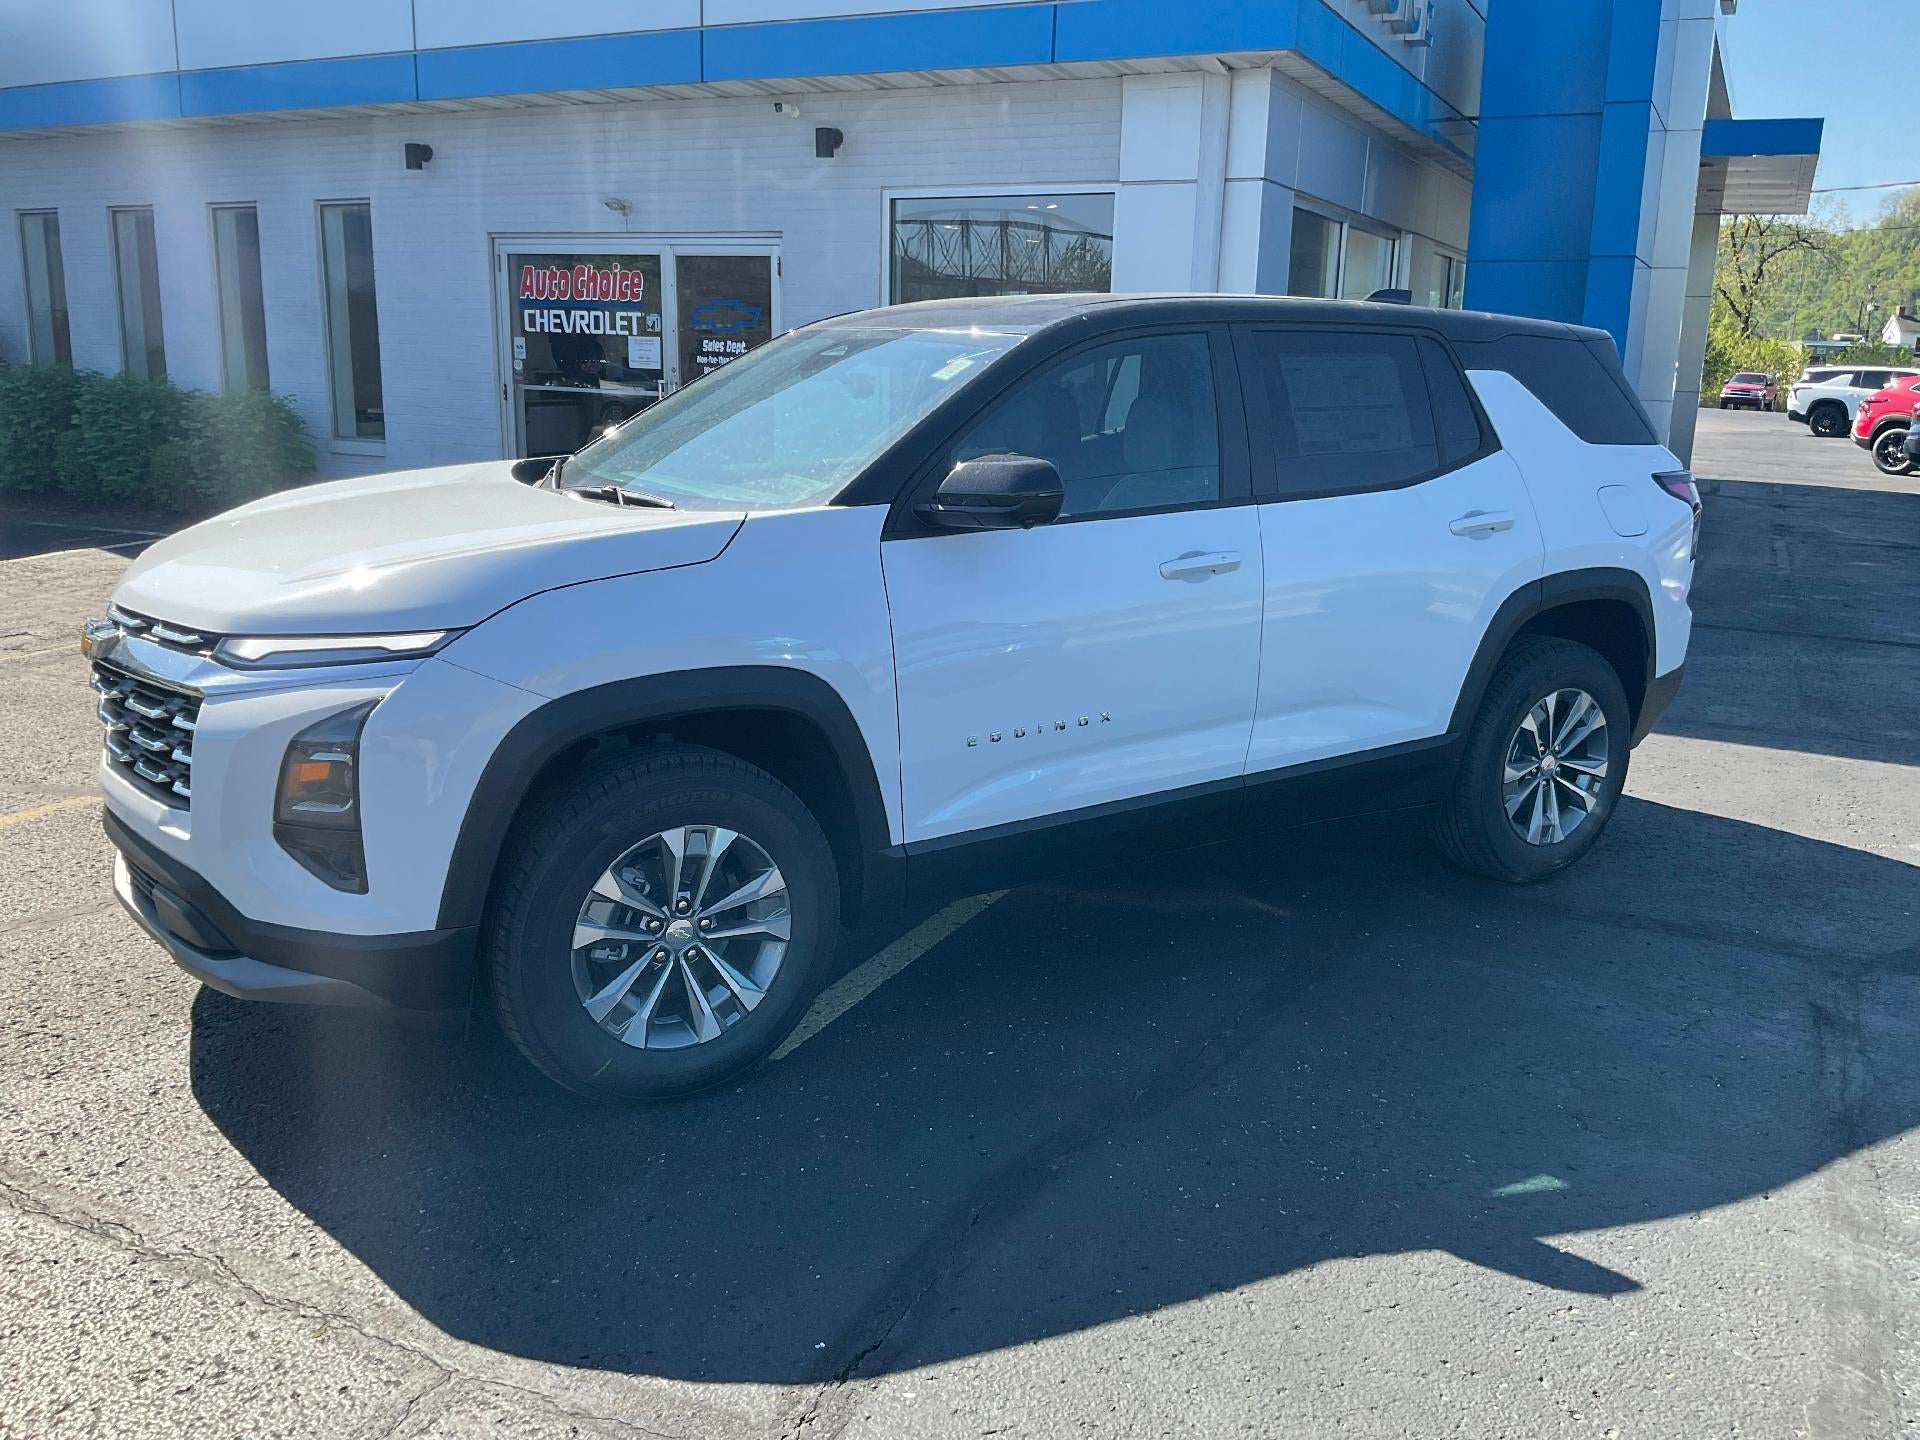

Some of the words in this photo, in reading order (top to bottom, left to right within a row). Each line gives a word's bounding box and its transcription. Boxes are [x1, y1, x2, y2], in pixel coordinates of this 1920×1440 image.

[520, 265, 571, 301] Auto
[572, 262, 644, 302] Choice
[523, 309, 641, 336] CHEVROLET
[703, 340, 724, 352] Sales
[726, 341, 748, 354] Dept.
[966, 711, 1111, 747] EQUINOX
